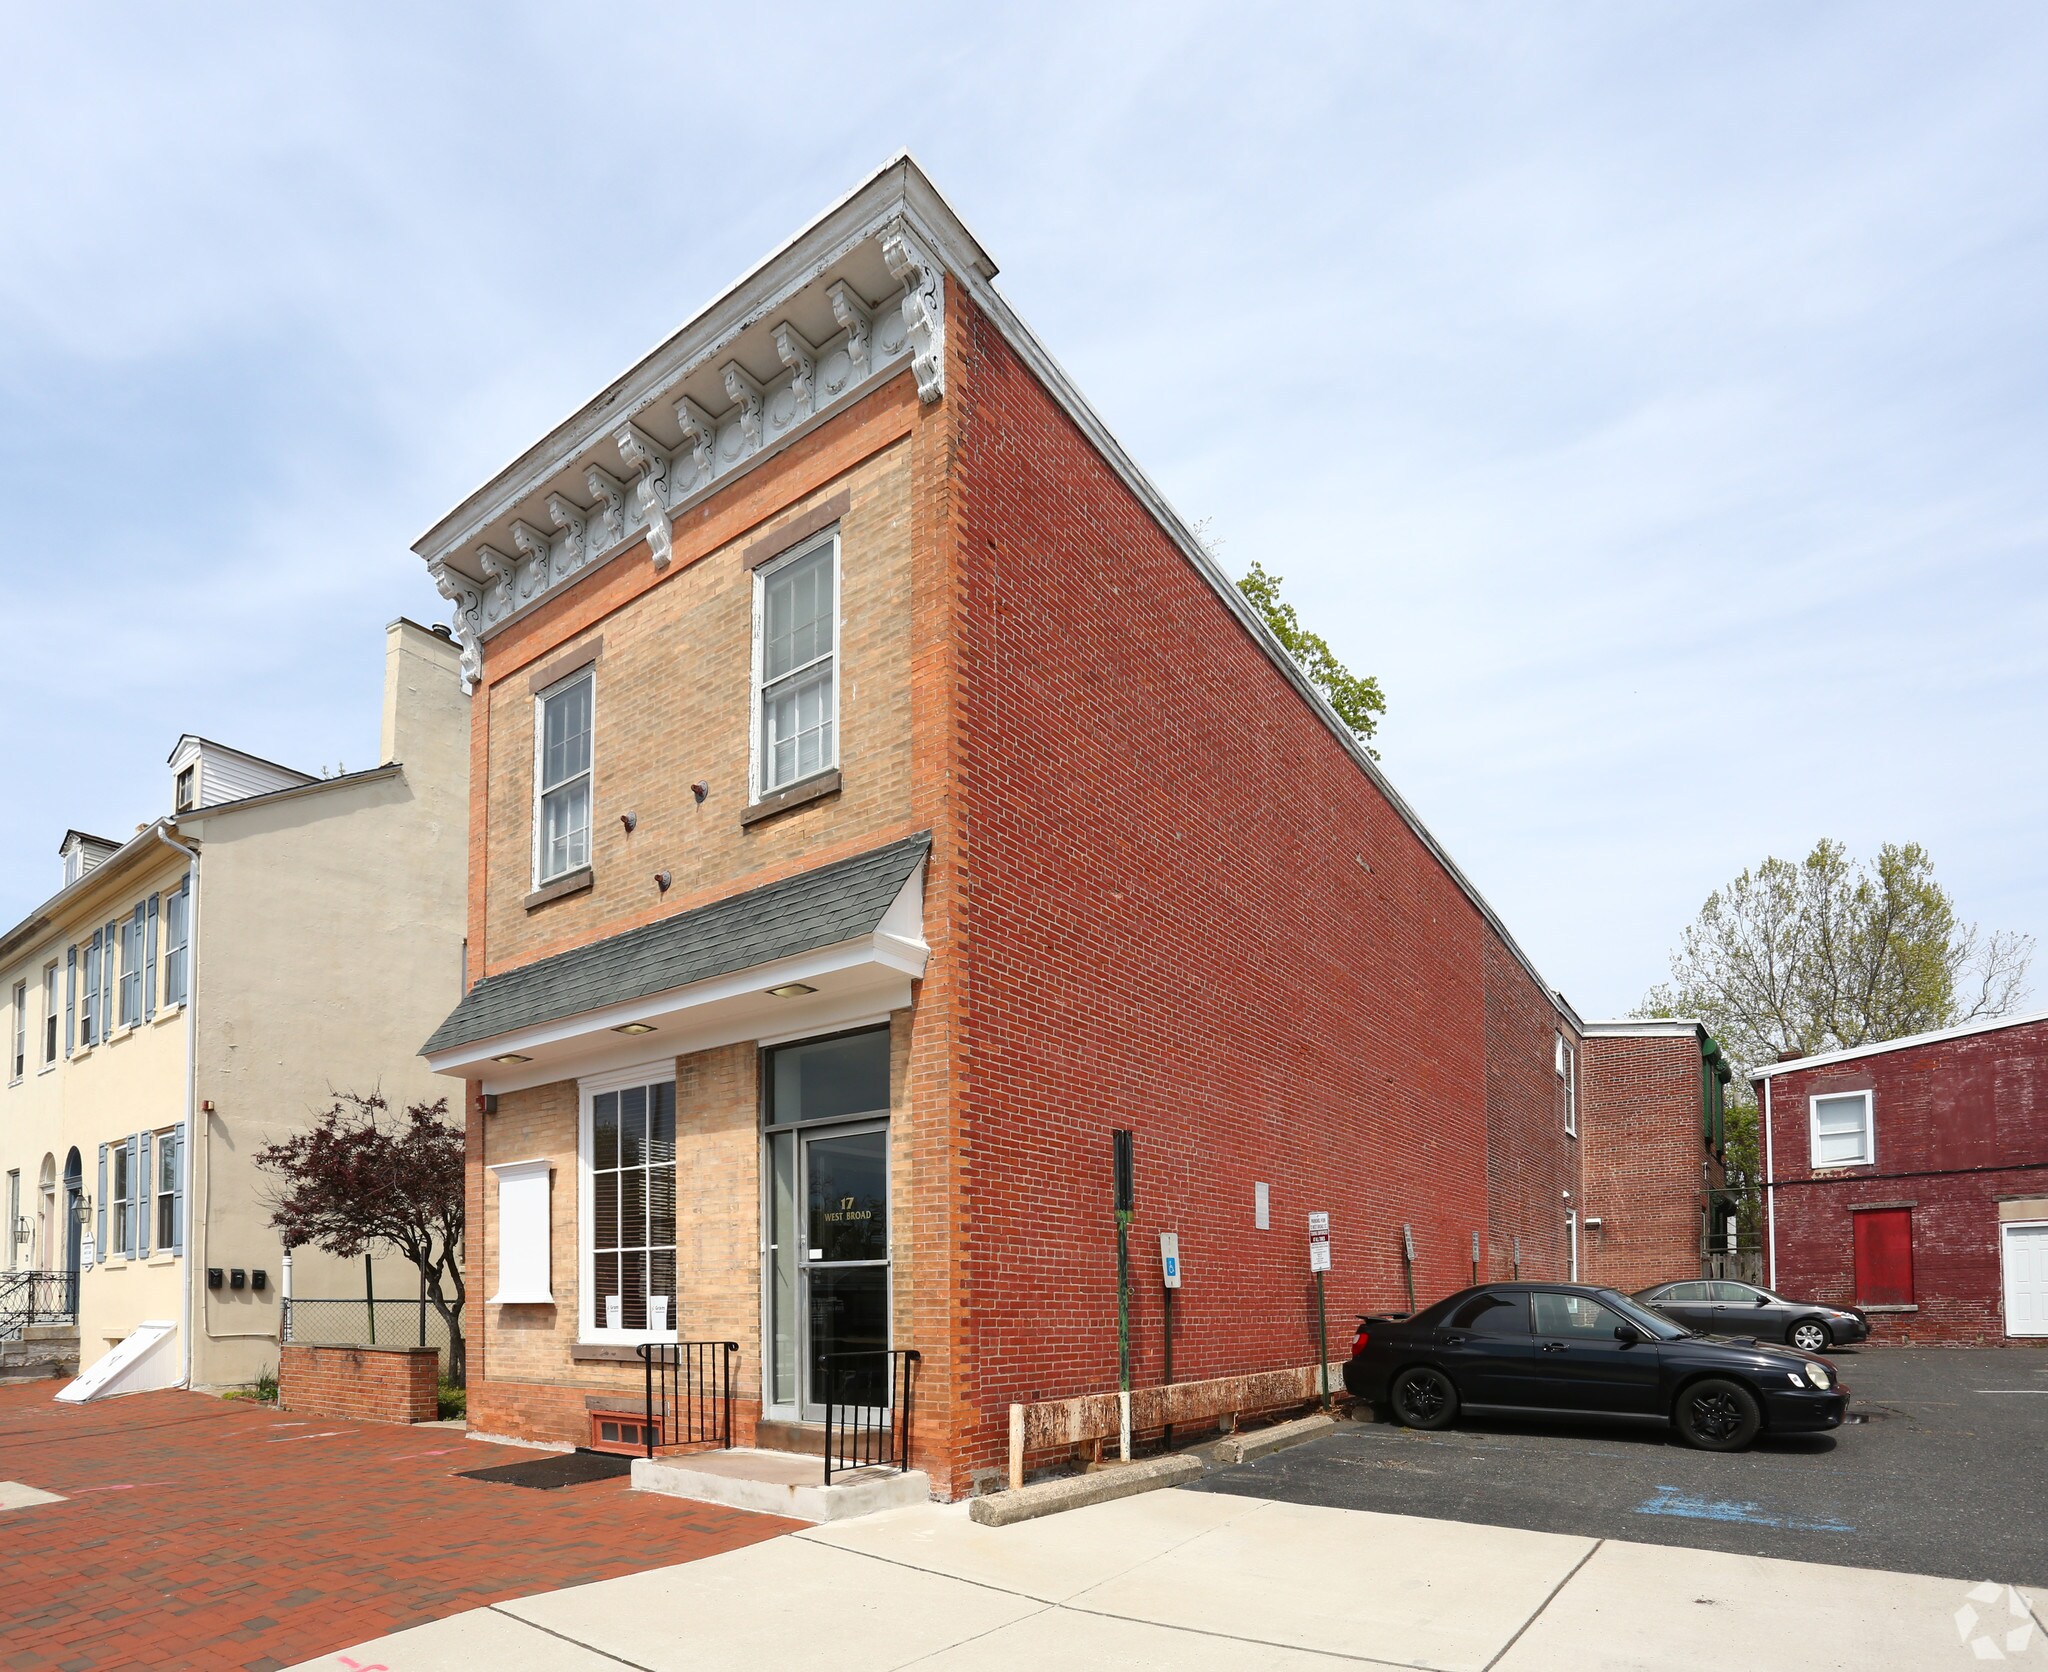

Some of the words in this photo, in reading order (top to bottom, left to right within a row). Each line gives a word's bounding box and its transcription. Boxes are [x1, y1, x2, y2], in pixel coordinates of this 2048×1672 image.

[841, 1197, 854, 1210] 17
[824, 1213, 843, 1221] WEST
[847, 1211, 871, 1220] BROAD
